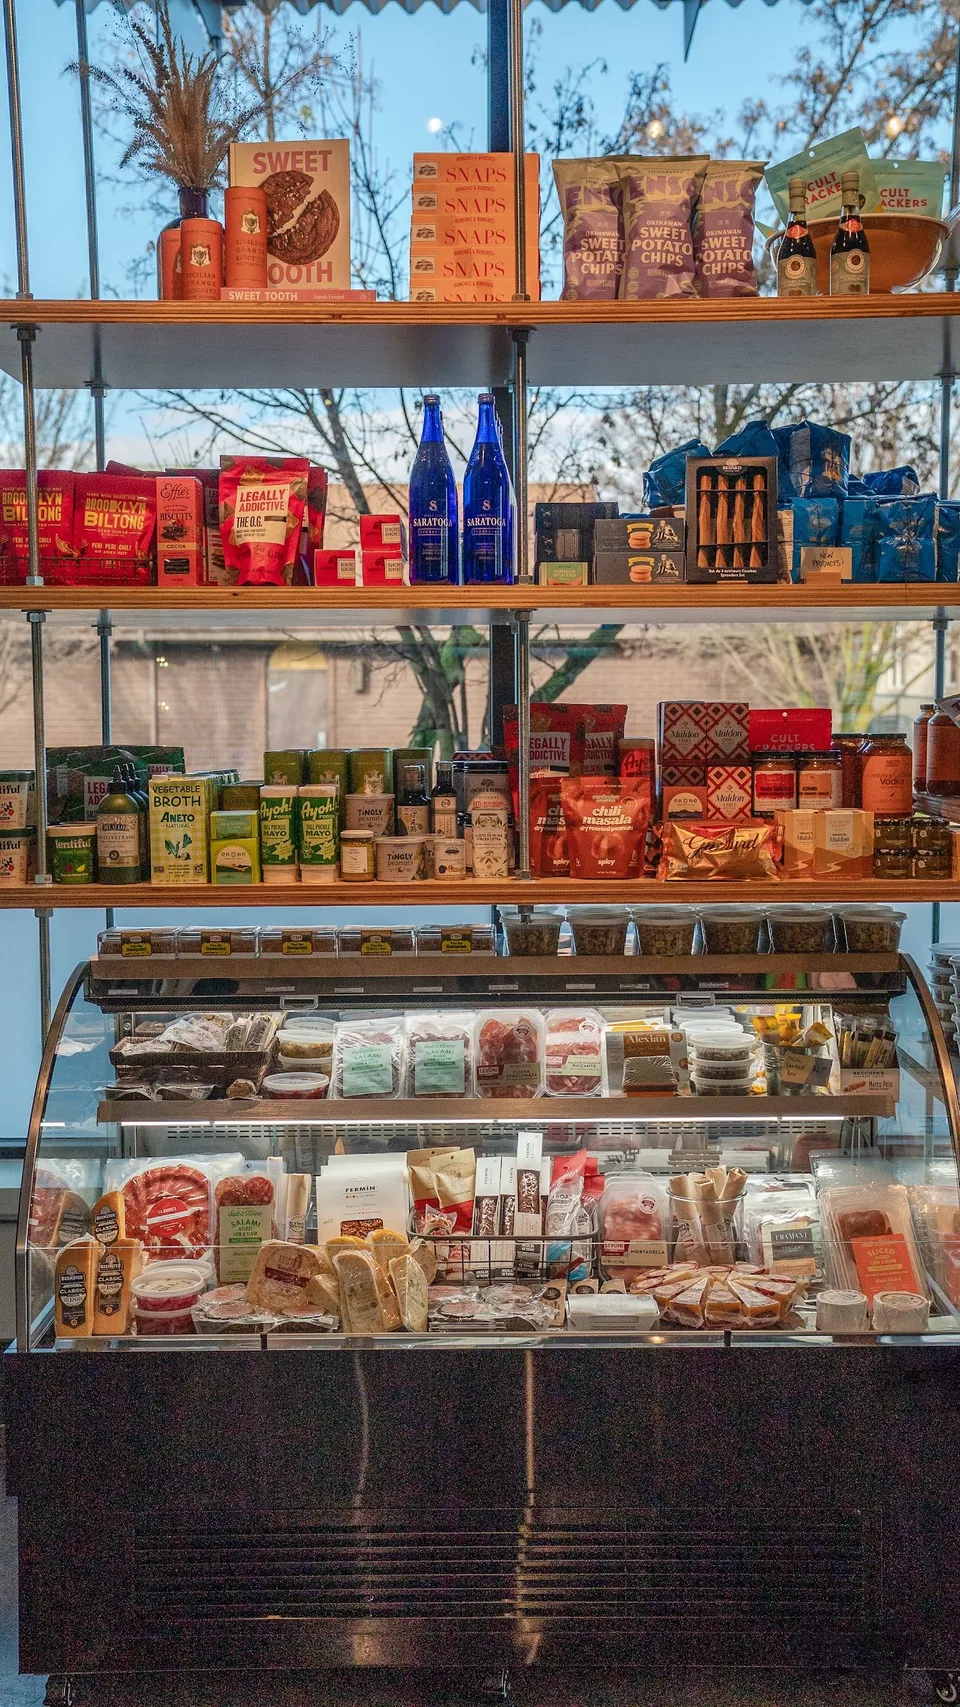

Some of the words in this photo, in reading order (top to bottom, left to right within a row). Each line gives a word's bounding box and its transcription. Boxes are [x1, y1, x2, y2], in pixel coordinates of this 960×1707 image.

[252, 150, 332, 174] SWEET
[446, 168, 506, 183] SNAPS
[807, 172, 837, 192] CULT
[629, 176, 697, 202] ENSO
[804, 182, 843, 206] RACKE
[880, 188, 909, 198] CULT
[444, 198, 506, 213] SNAPS
[880, 199, 928, 208] ACKERS
[444, 230, 506, 244] SNAPS
[640, 227, 687, 240] SWEET
[580, 239, 625, 250] SWEET
[631, 239, 693, 255] POTATO
[702, 236, 746, 250] SWEET
[641, 252, 683, 267] CHIPS
[268, 262, 332, 284] OOTH
[443, 262, 505, 277] SNAPS
[581, 264, 623, 275] CHIPS
[702, 262, 745, 275] CHIPS
[228, 292, 264, 300] SWEET
[265, 292, 297, 300] TOOTH
[240, 490, 285, 502] LEGALLY
[86, 498, 146, 515] BROOKLYN
[239, 501, 285, 512] ADDICTIVE
[2, 506, 62, 522] BILONG
[84, 511, 144, 530] BILTONG
[237, 517, 249, 528] THE
[250, 516, 263, 527] O.G.
[413, 518, 453, 527] SARATOGA
[467, 518, 506, 527] SARATOGA
[671, 730, 699, 739] Maldon
[714, 729, 743, 738] Maldon
[771, 734, 799, 743] CULT
[530, 738, 566, 750] EGALLY
[585, 738, 612, 749] GALLY
[530, 750, 566, 761] DDICTIVE
[152, 785, 200, 793] VEGETABLE
[154, 796, 201, 807] BROTH
[715, 794, 745, 802] Maldon
[260, 797, 292, 821] Ayoh!
[301, 798, 335, 821] Ayoh!
[592, 806, 622, 816] chili
[160, 812, 195, 823] ANETO
[582, 816, 631, 826] masala
[55, 839, 91, 849] lentiful
[627, 1035, 666, 1043] Alexian
[231, 1219, 261, 1227] SALAMI
[867, 1248, 895, 1257] SLICED
